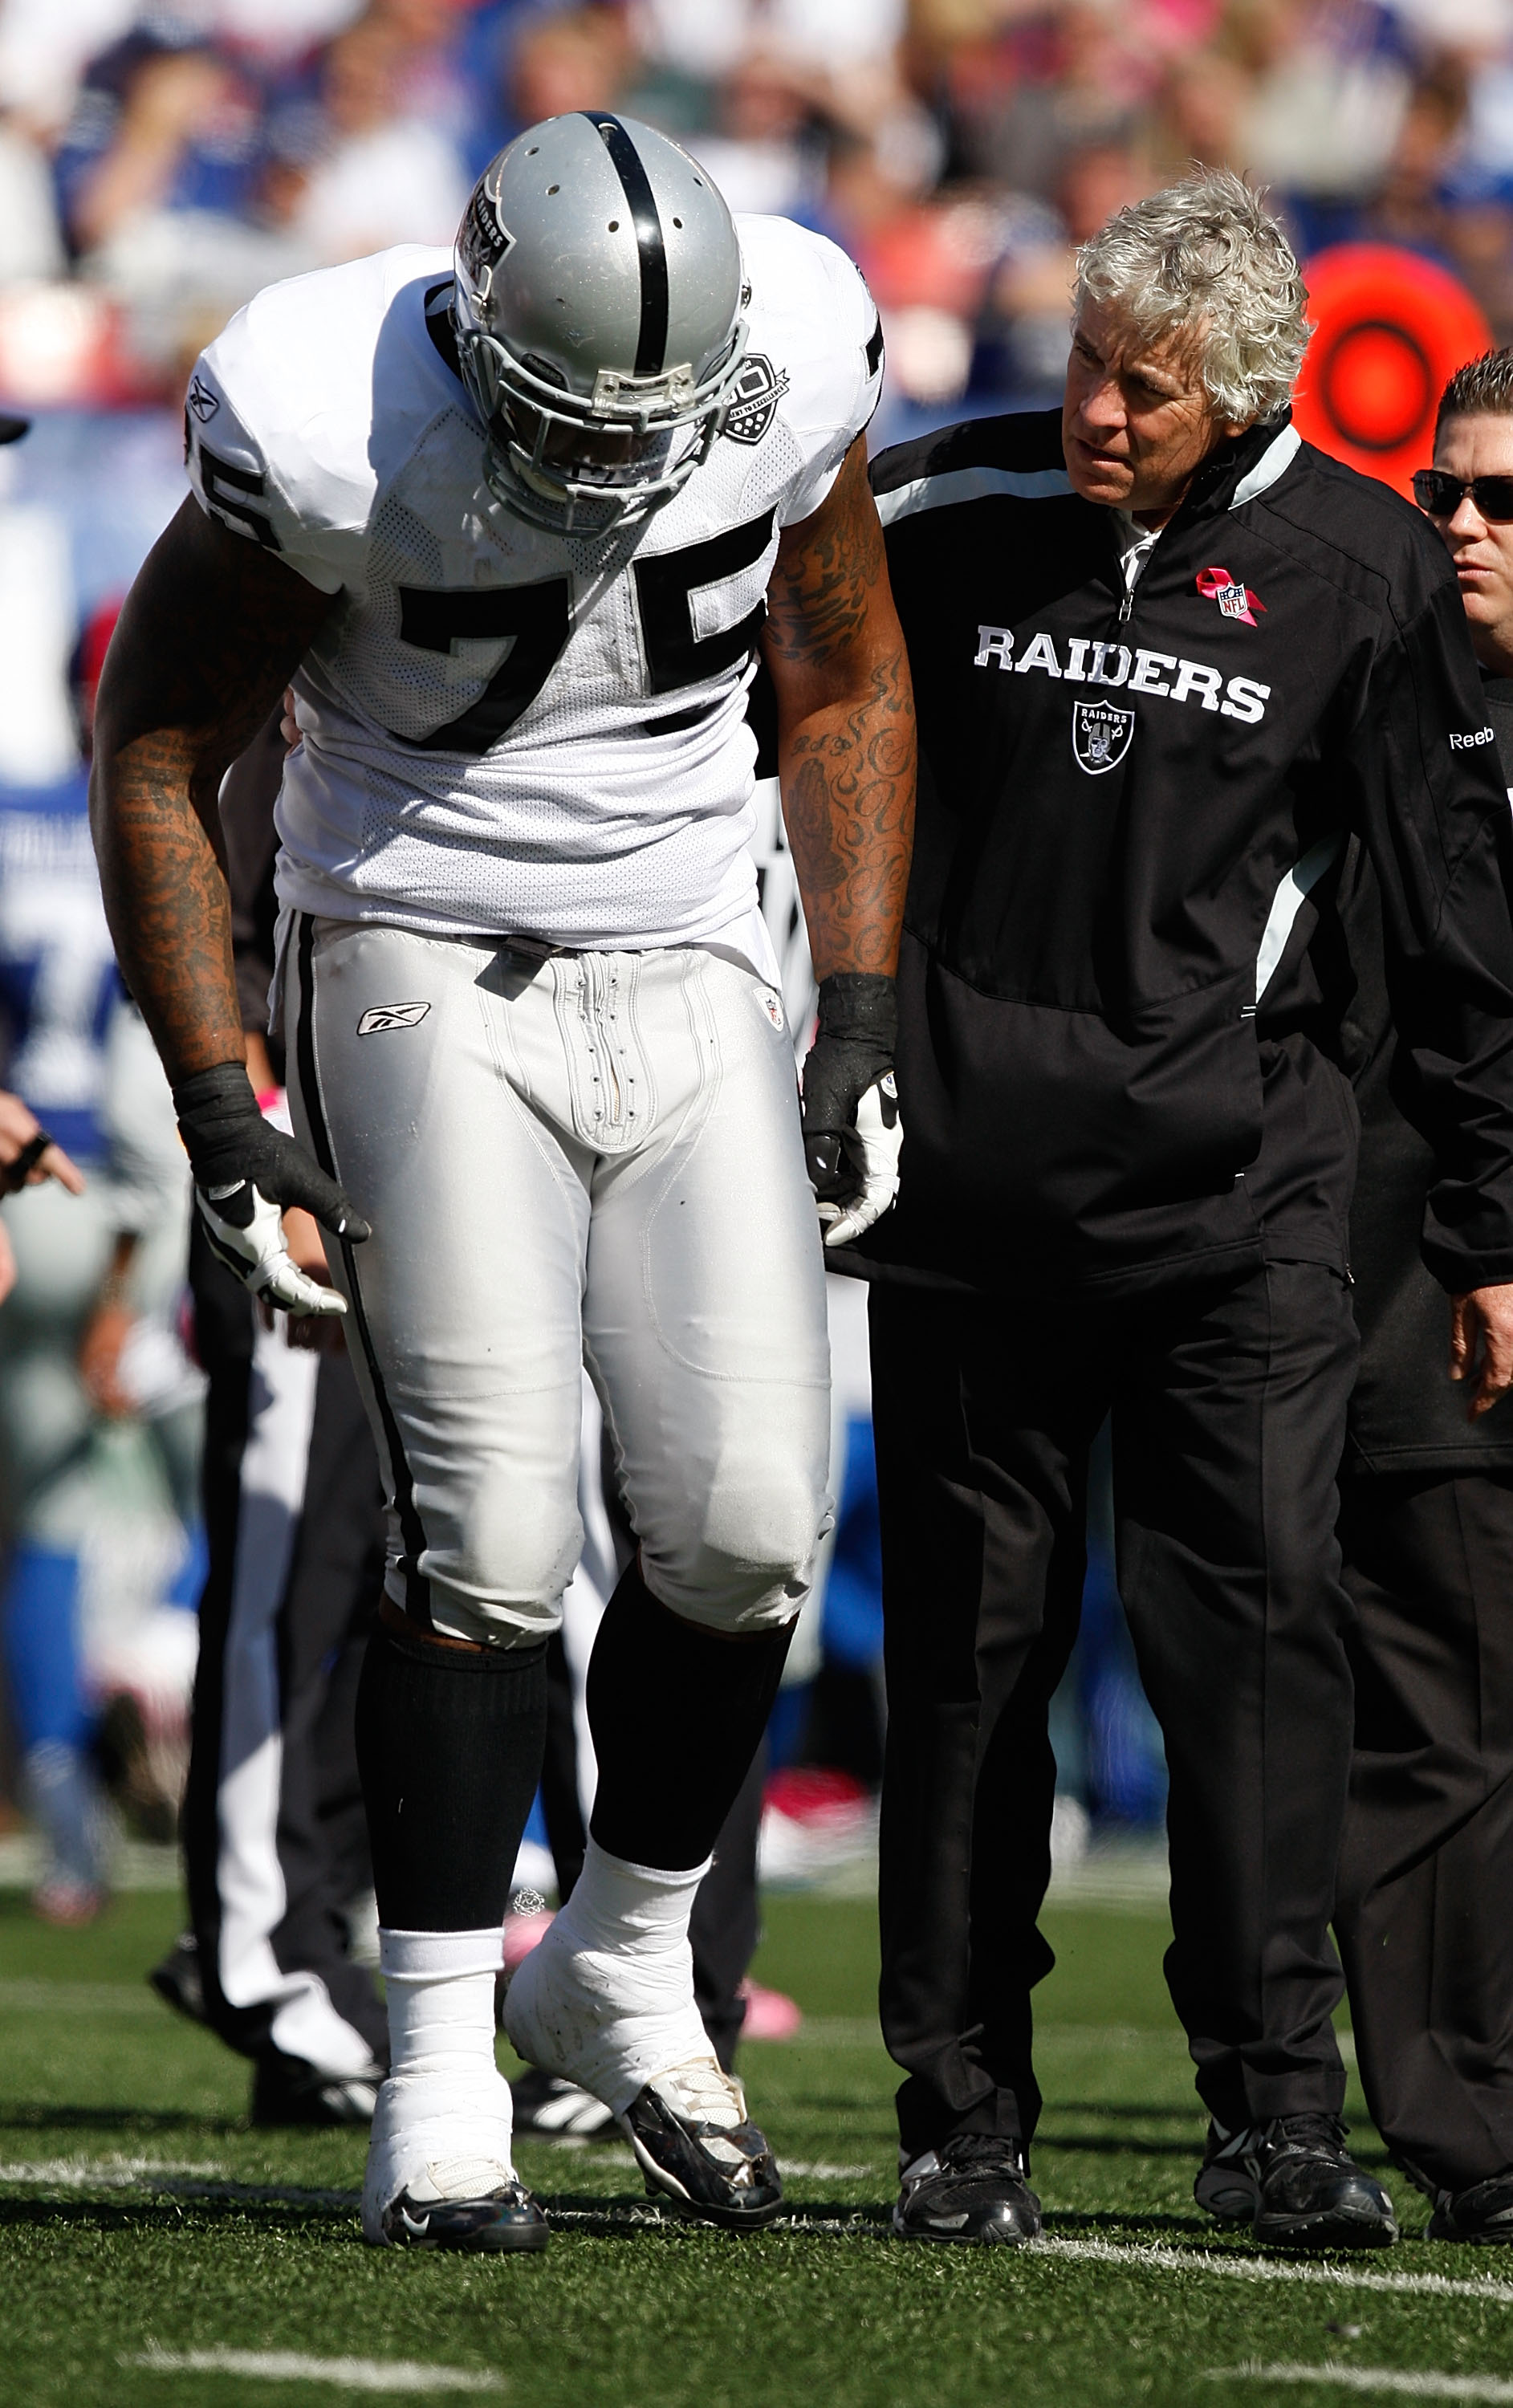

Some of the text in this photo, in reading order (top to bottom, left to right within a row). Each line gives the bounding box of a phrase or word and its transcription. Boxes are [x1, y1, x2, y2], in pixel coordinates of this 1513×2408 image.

[1222, 597, 1245, 613] NFL
[388, 502, 779, 755] 75
[974, 624, 1271, 724] RAIDERS
[1081, 708, 1128, 724] RAIDERS
[1449, 726, 1495, 750] Reeb
